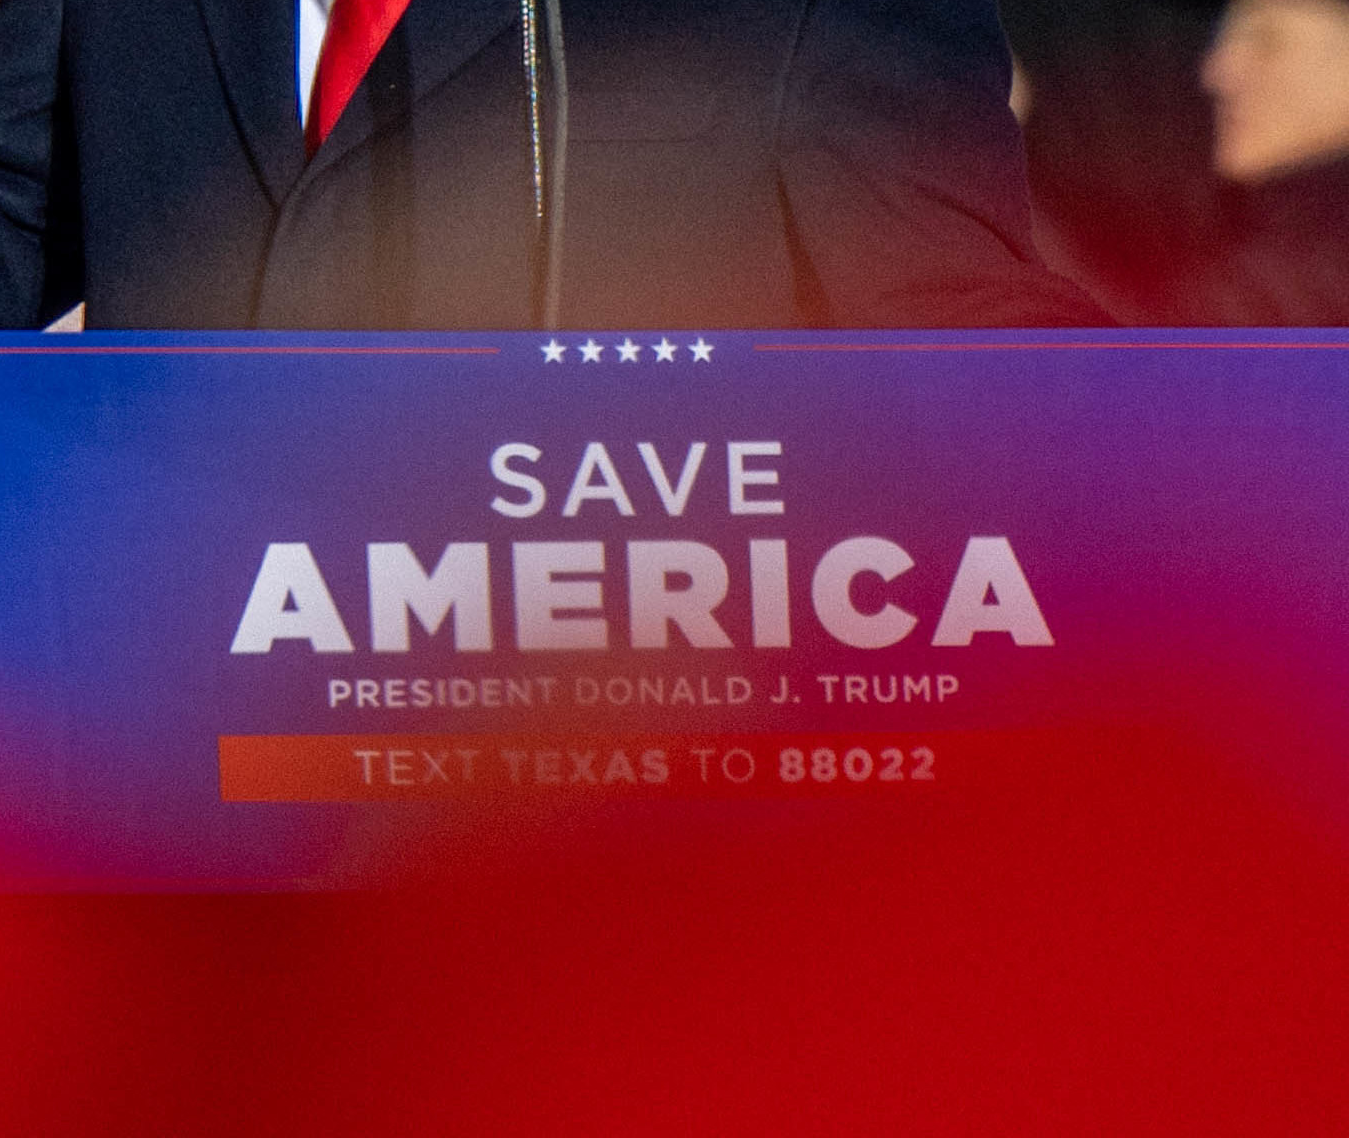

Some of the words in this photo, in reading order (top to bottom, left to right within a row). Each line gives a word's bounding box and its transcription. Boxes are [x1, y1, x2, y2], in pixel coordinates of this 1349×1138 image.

[489, 440, 785, 518] SAVE
[229, 535, 1056, 654] AMERICA
[327, 677, 553, 709] PRESIDENT
[573, 676, 751, 707] DONALD
[769, 674, 801, 704] J.
[816, 673, 960, 704] TRUMP
[353, 749, 481, 786] TEXT
[499, 747, 670, 785] TEXAS
[689, 747, 756, 784] TO
[777, 746, 936, 784] 88022
